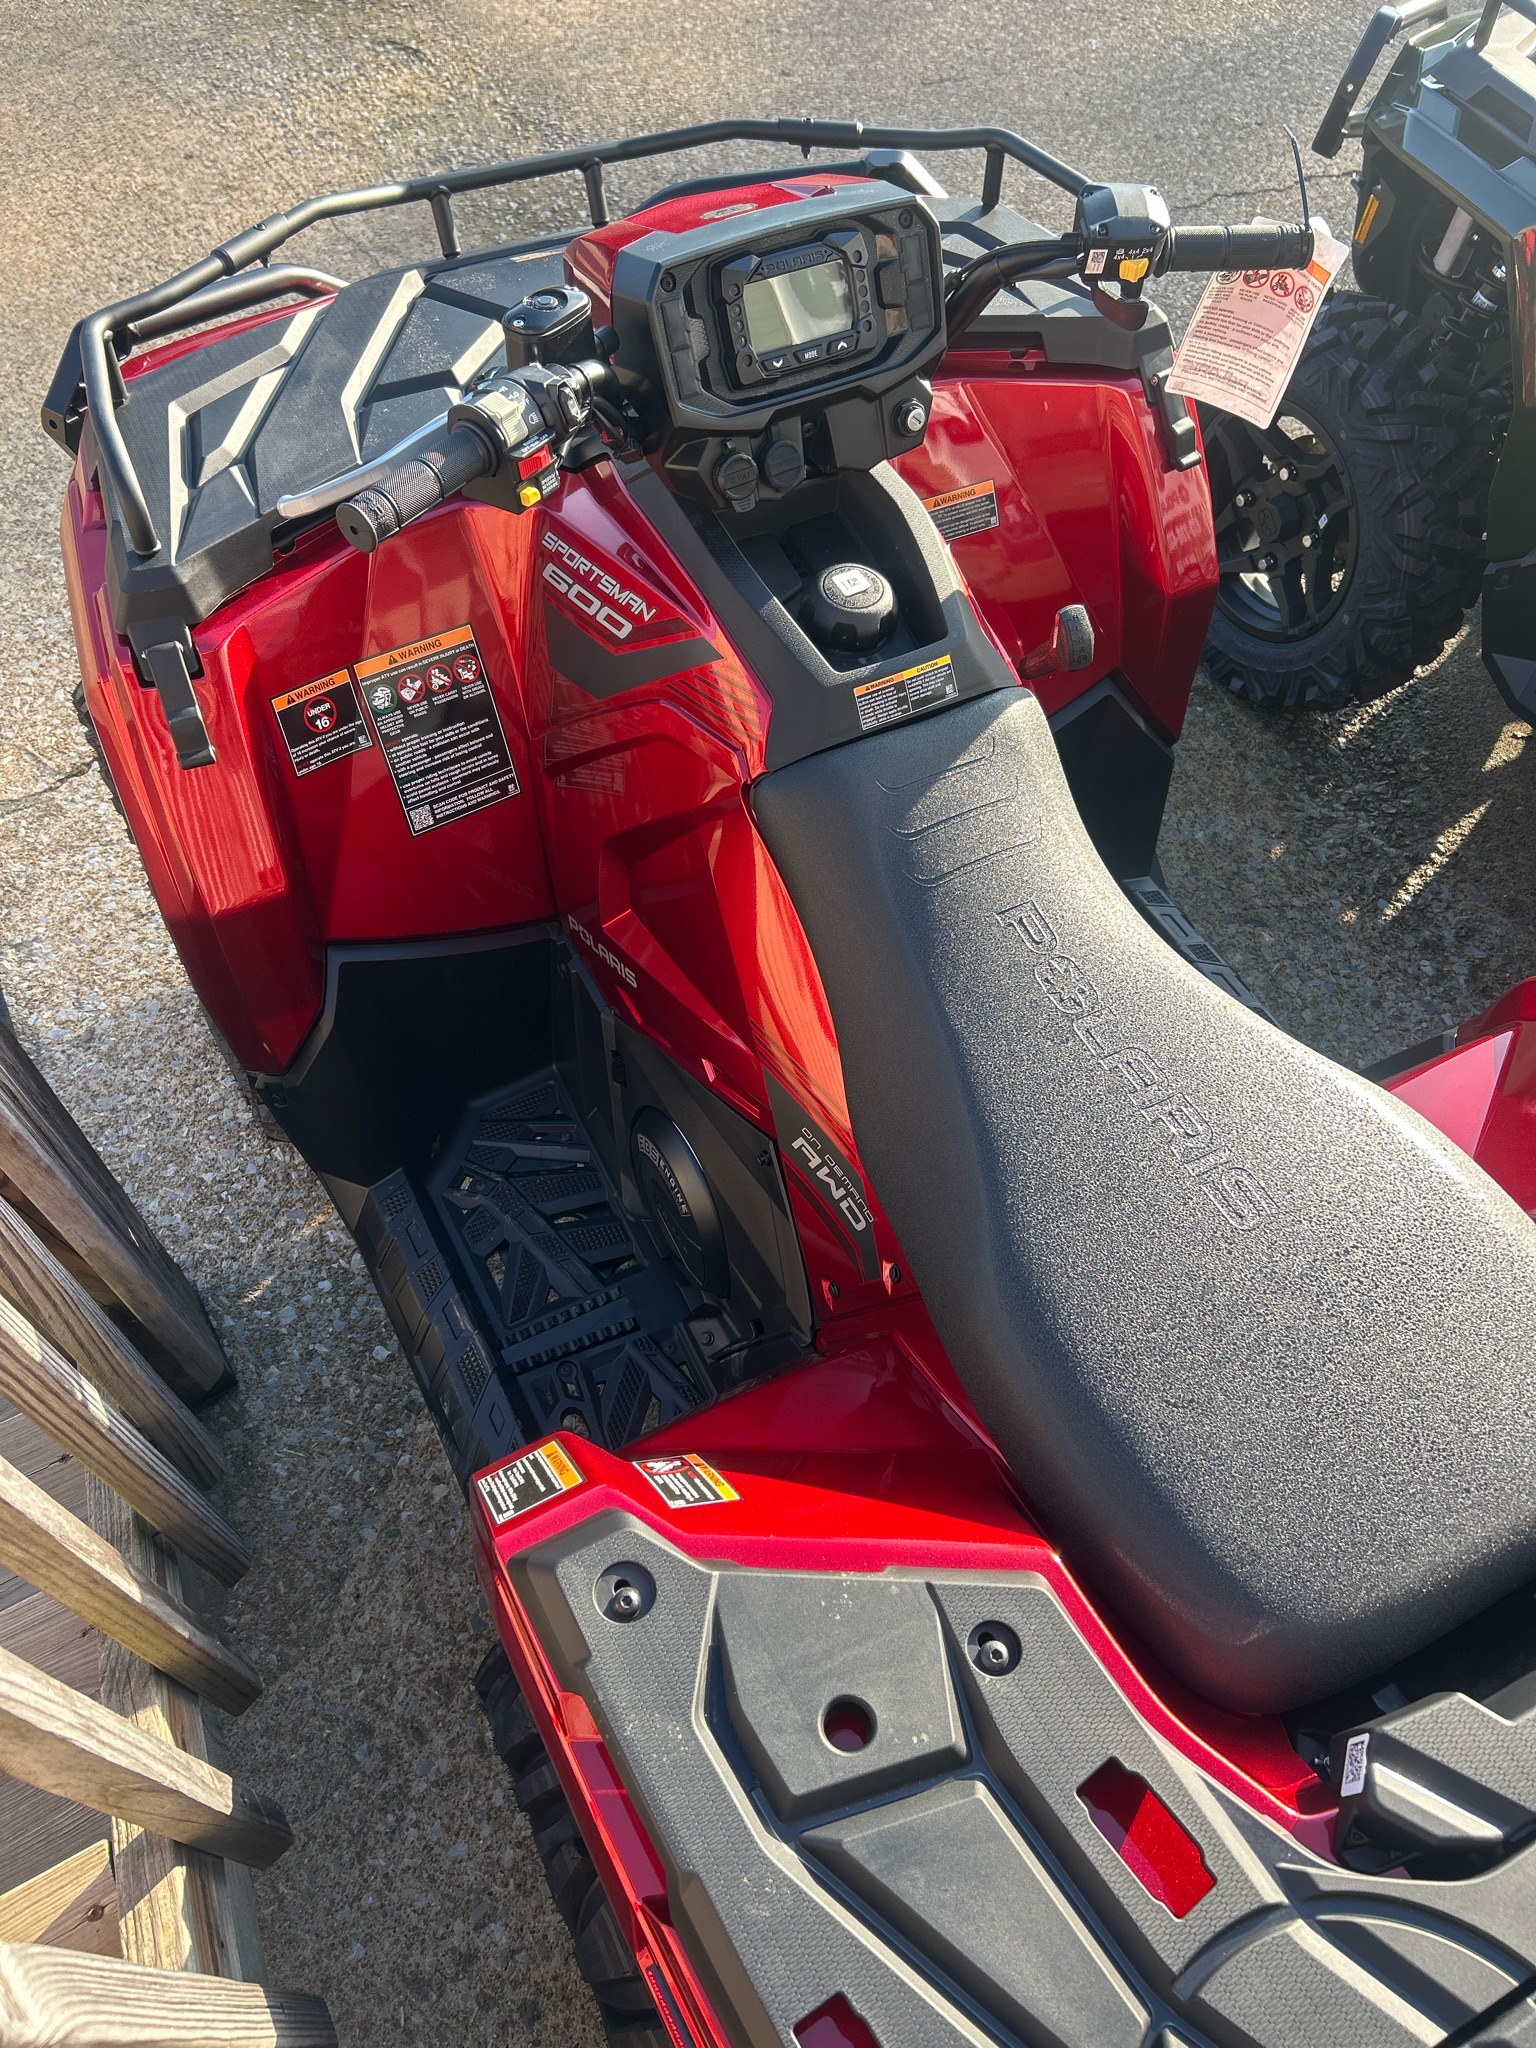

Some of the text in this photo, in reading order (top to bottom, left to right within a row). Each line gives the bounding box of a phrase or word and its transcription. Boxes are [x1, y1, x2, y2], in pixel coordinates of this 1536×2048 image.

[764, 250, 825, 275] POLARIS
[804, 349, 818, 360] MODE
[939, 488, 975, 504] WARNING
[541, 530, 657, 622] SPORTSMAN
[542, 562, 633, 640] 600
[398, 638, 442, 660] WARNING
[869, 661, 938, 689] WARNING CAUTION
[294, 677, 335, 700] WARNING
[306, 702, 330, 717] UNDER
[314, 715, 330, 730] 16
[568, 914, 638, 988] POLARIS
[994, 899, 1280, 1231] POLARIS
[639, 1136, 658, 1163] EBS
[660, 1159, 689, 1214] ENGINE
[791, 1136, 867, 1232] AWD
[824, 1154, 874, 1223] DEMAND
[550, 1454, 568, 1477] WARNING
